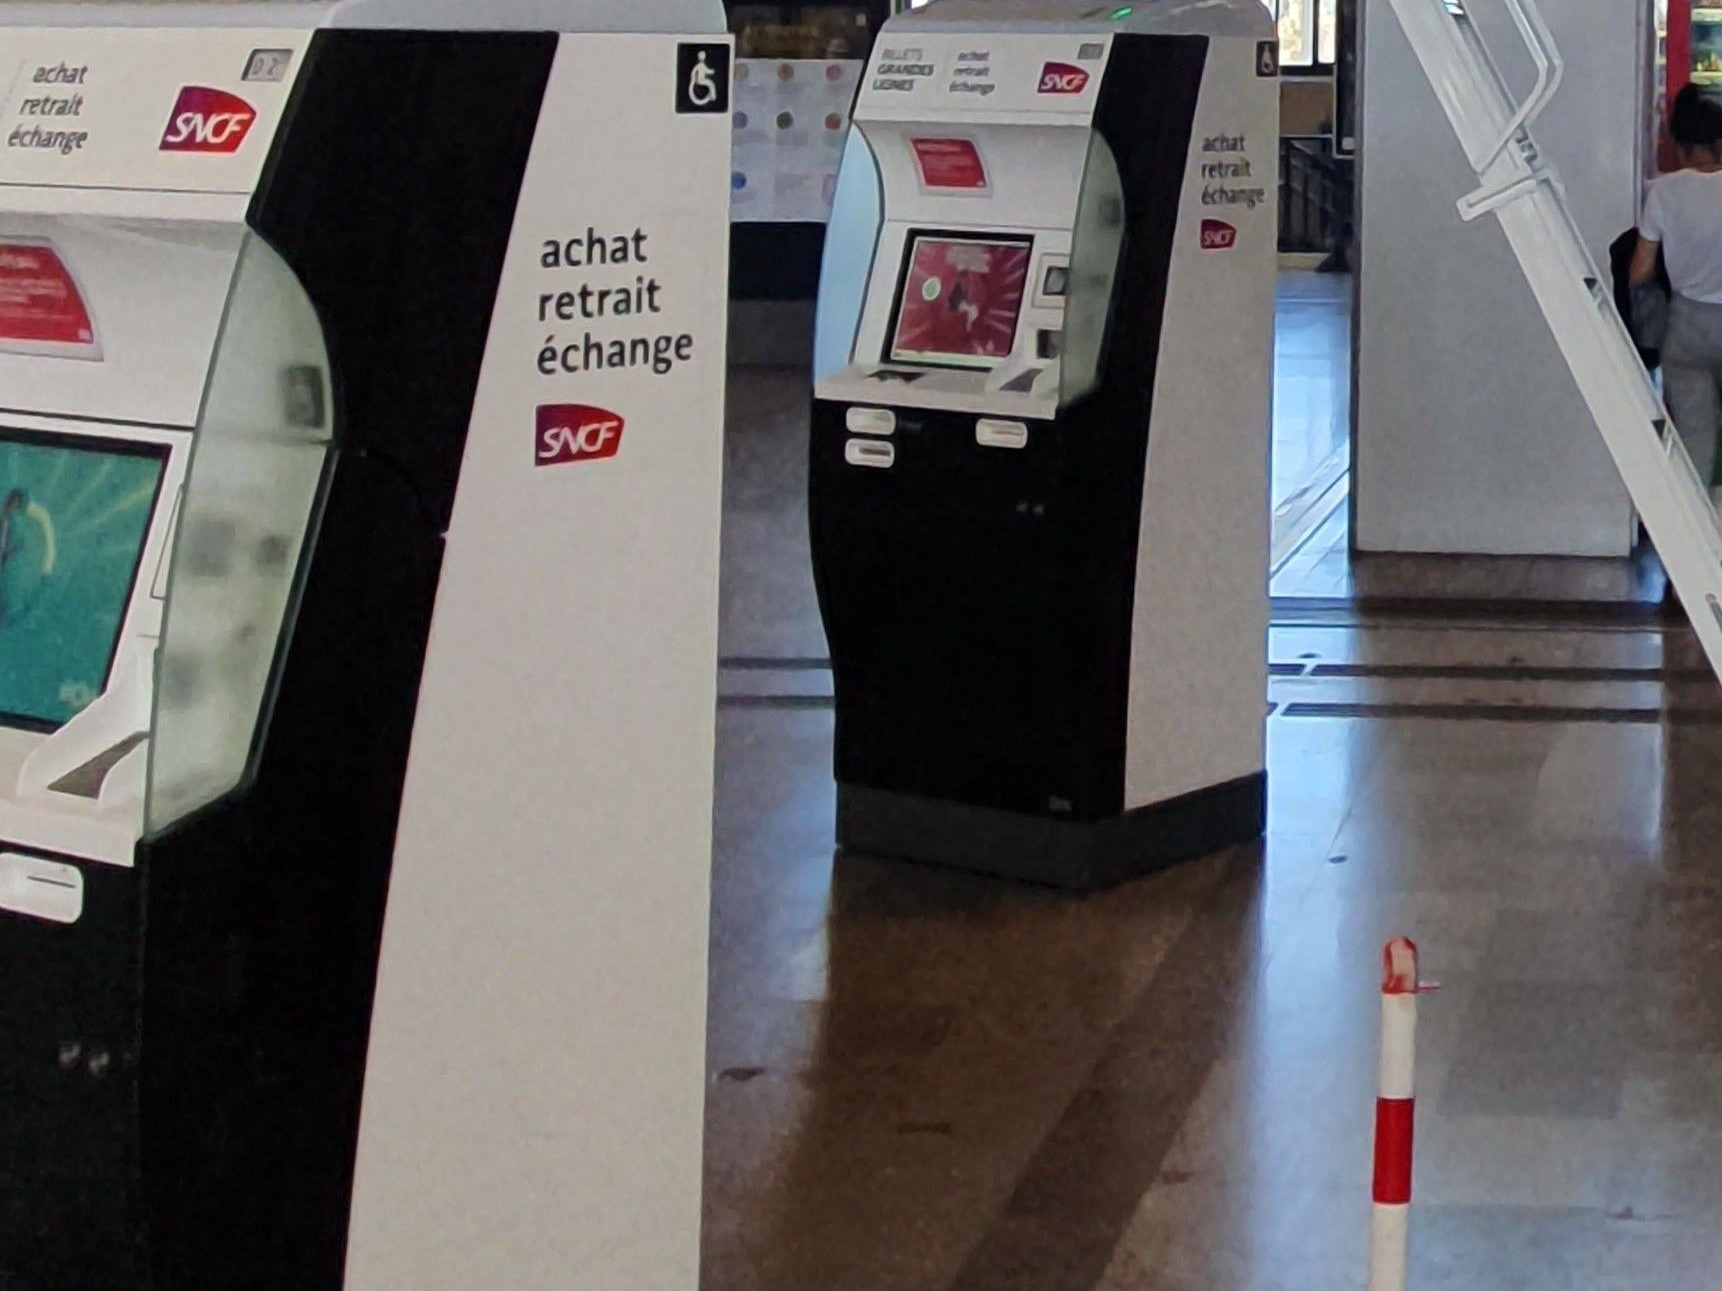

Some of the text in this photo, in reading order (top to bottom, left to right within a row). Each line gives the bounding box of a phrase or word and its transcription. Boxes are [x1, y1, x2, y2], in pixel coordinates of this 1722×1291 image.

[33, 60, 88, 84] achat
[1041, 72, 1086, 91] SNCF
[19, 95, 84, 117] retrait
[8, 124, 88, 154] échange
[166, 111, 251, 144] SNCF
[1202, 132, 1245, 152] achat
[1201, 159, 1252, 179] retrait
[1201, 183, 1266, 210] échange
[540, 227, 648, 269] achat
[1204, 229, 1233, 247] SNCF
[538, 275, 661, 322] retrait
[537, 331, 694, 376] échange
[539, 420, 620, 459] SNCF
